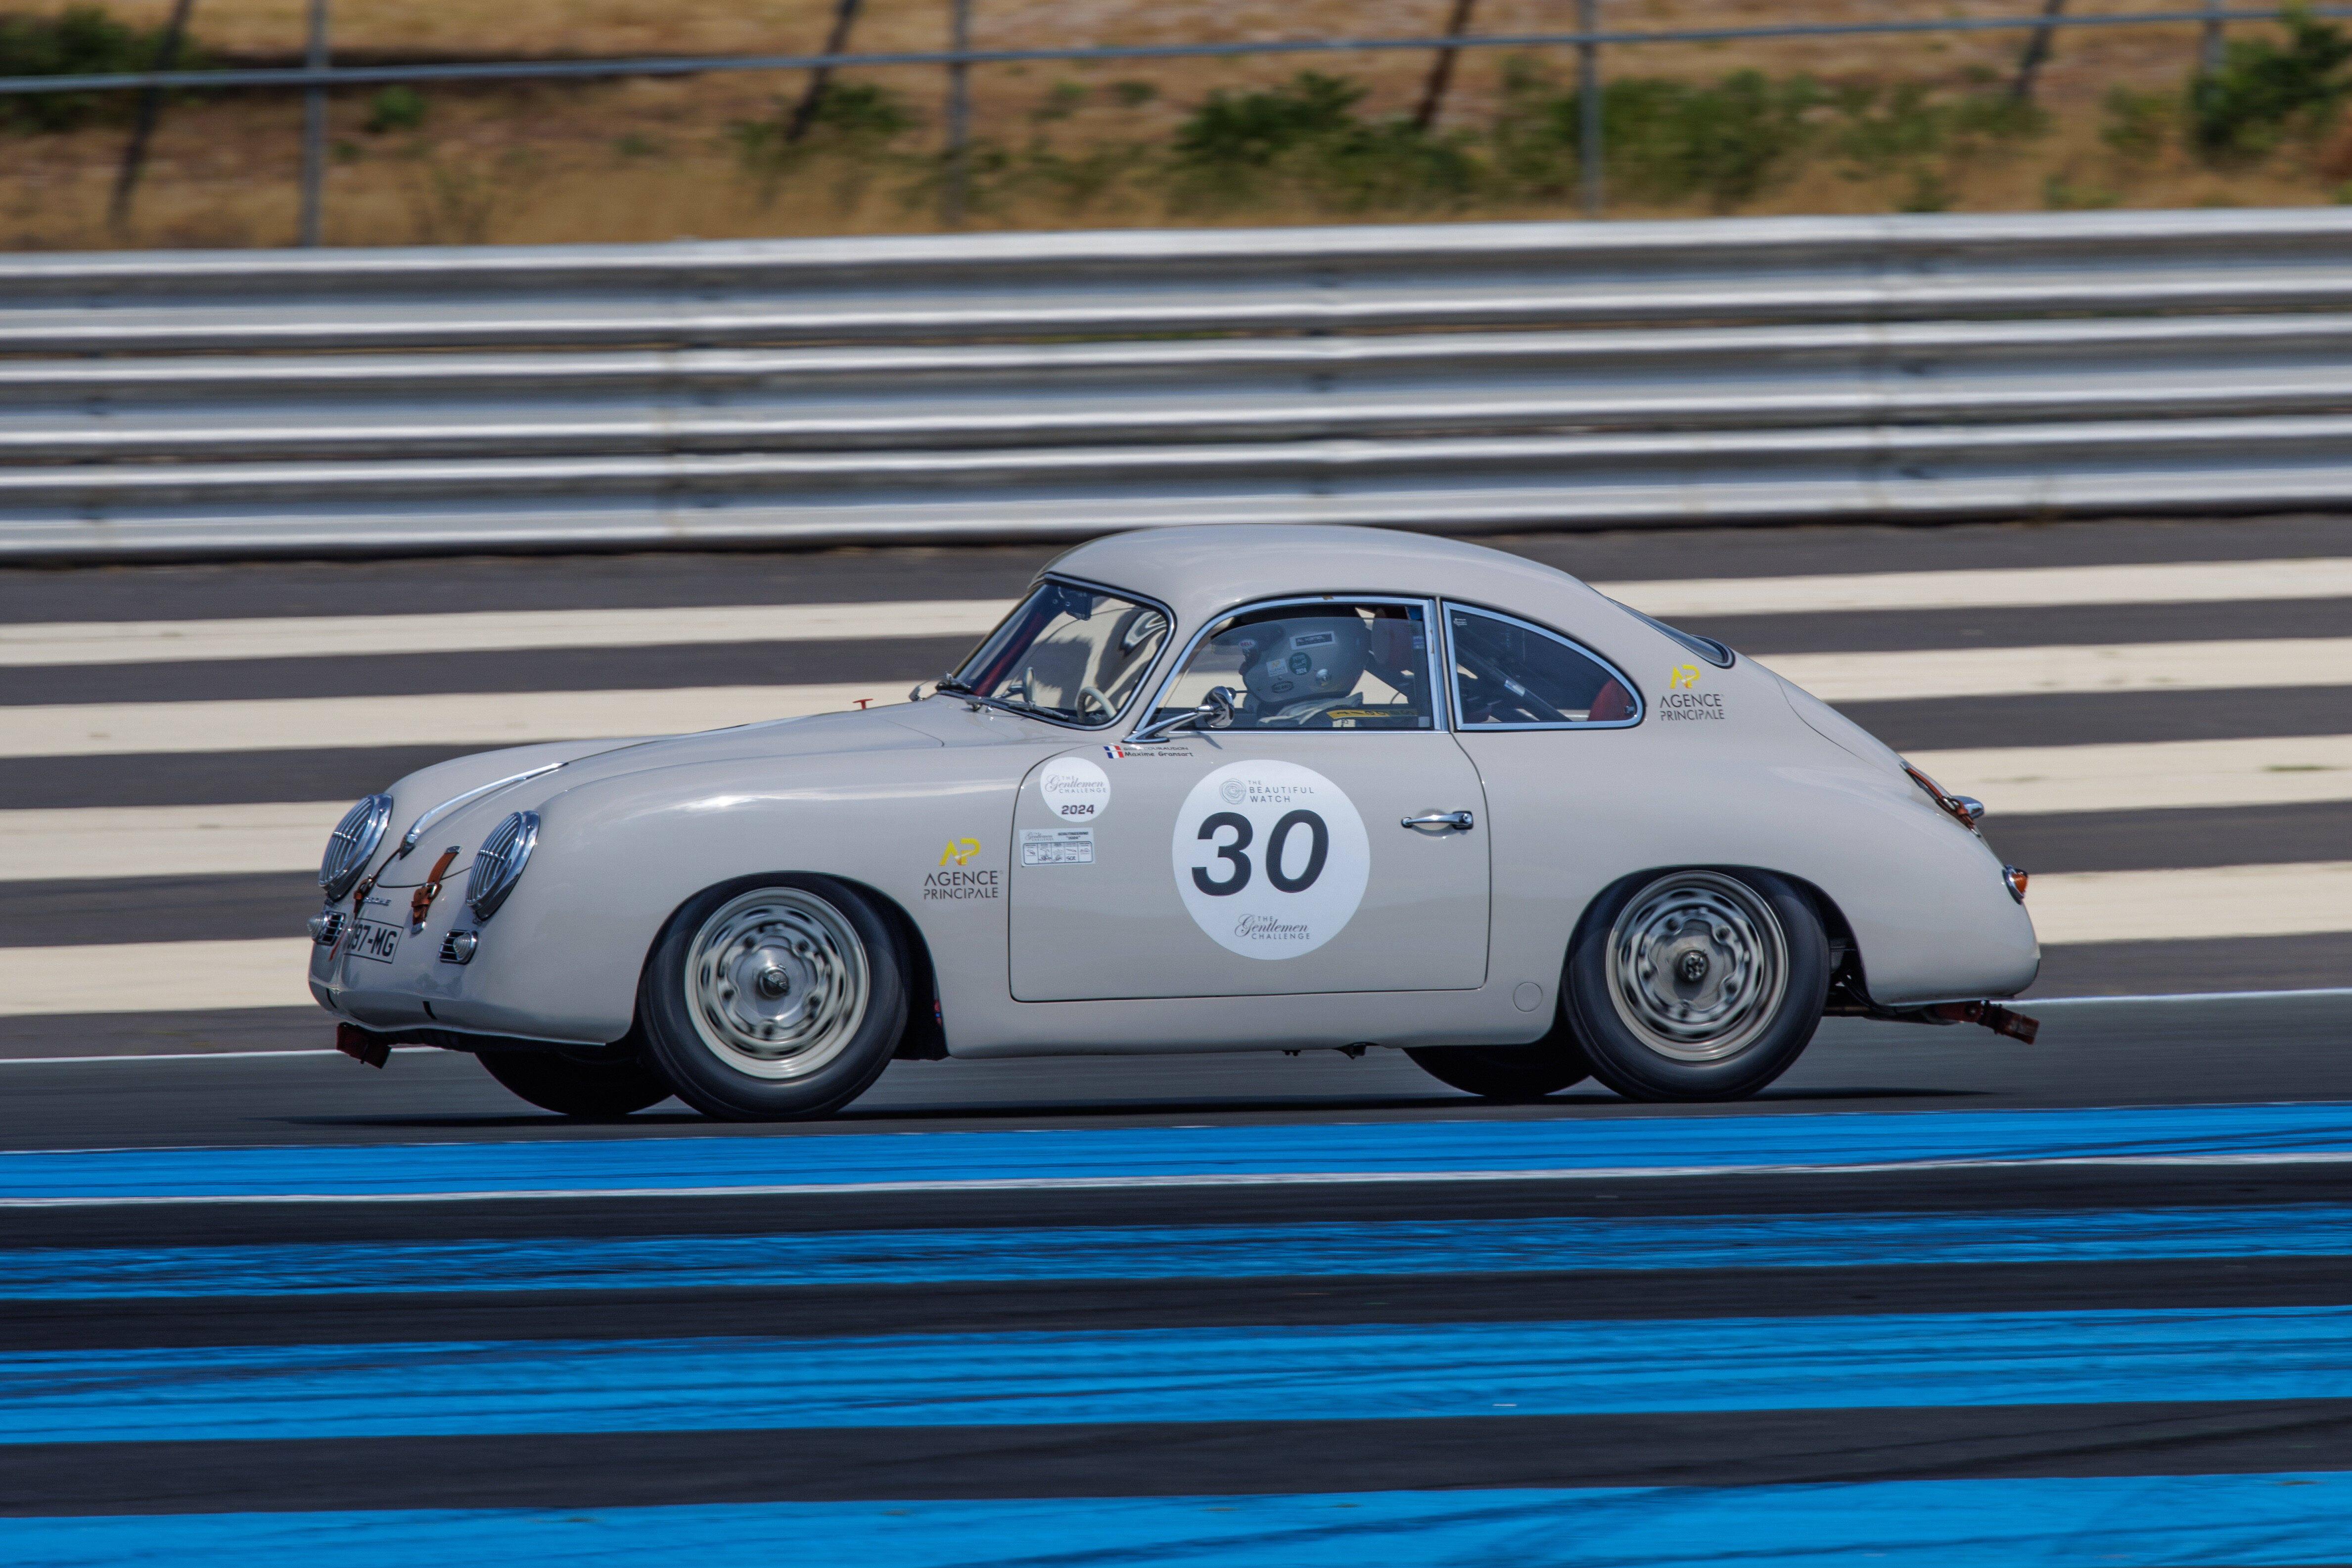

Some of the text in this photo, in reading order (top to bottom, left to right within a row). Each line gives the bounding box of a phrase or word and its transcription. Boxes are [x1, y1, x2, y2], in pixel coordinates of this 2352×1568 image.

[1660, 694, 1722, 708] AGENCE
[1660, 709, 1725, 721] PRINCIPALE
[1045, 774, 1104, 792] Gentlemen
[1061, 804, 1095, 815] 2024
[1192, 809, 1329, 897] 30
[924, 871, 999, 886] AGENCE
[924, 887, 999, 900] PRINCIPALE
[1234, 913, 1308, 937] Gentlemen
